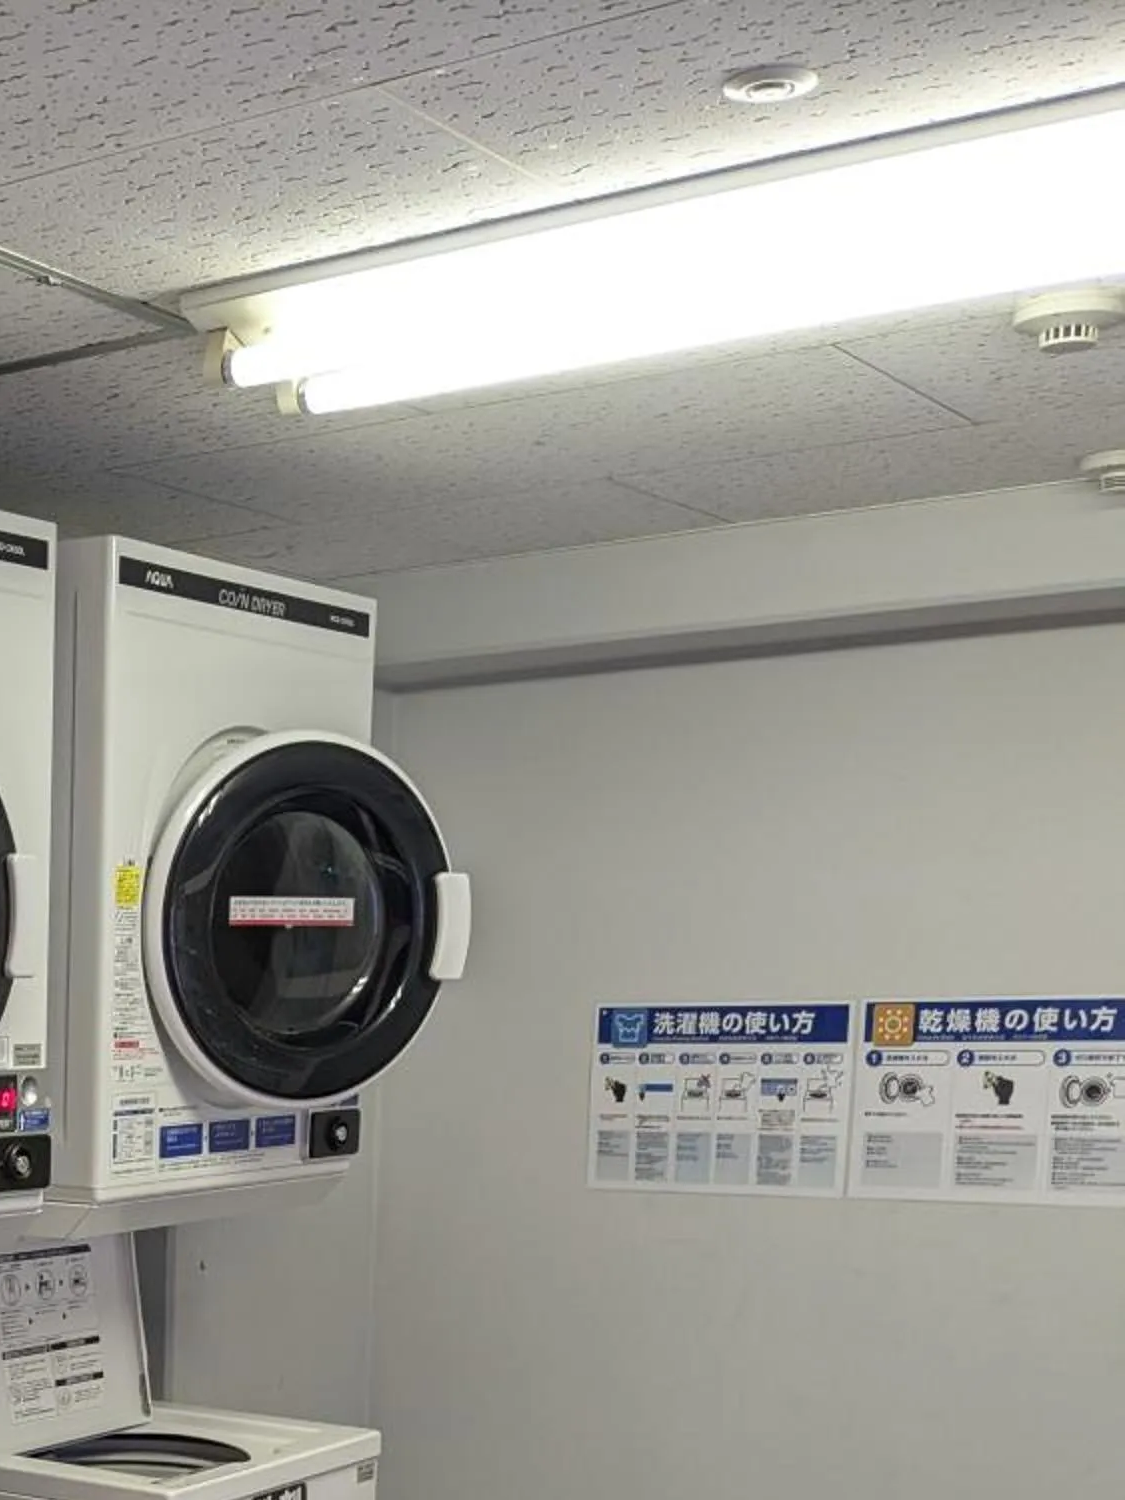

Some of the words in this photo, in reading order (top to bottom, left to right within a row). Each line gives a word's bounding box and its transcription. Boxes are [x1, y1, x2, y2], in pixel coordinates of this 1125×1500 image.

[145, 569, 173, 589] AQUA
[251, 595, 287, 617] DRYER
[653, 1010, 816, 1036] 洗濯機の使い方
[918, 1006, 1118, 1034] 乾燥機の使い方
